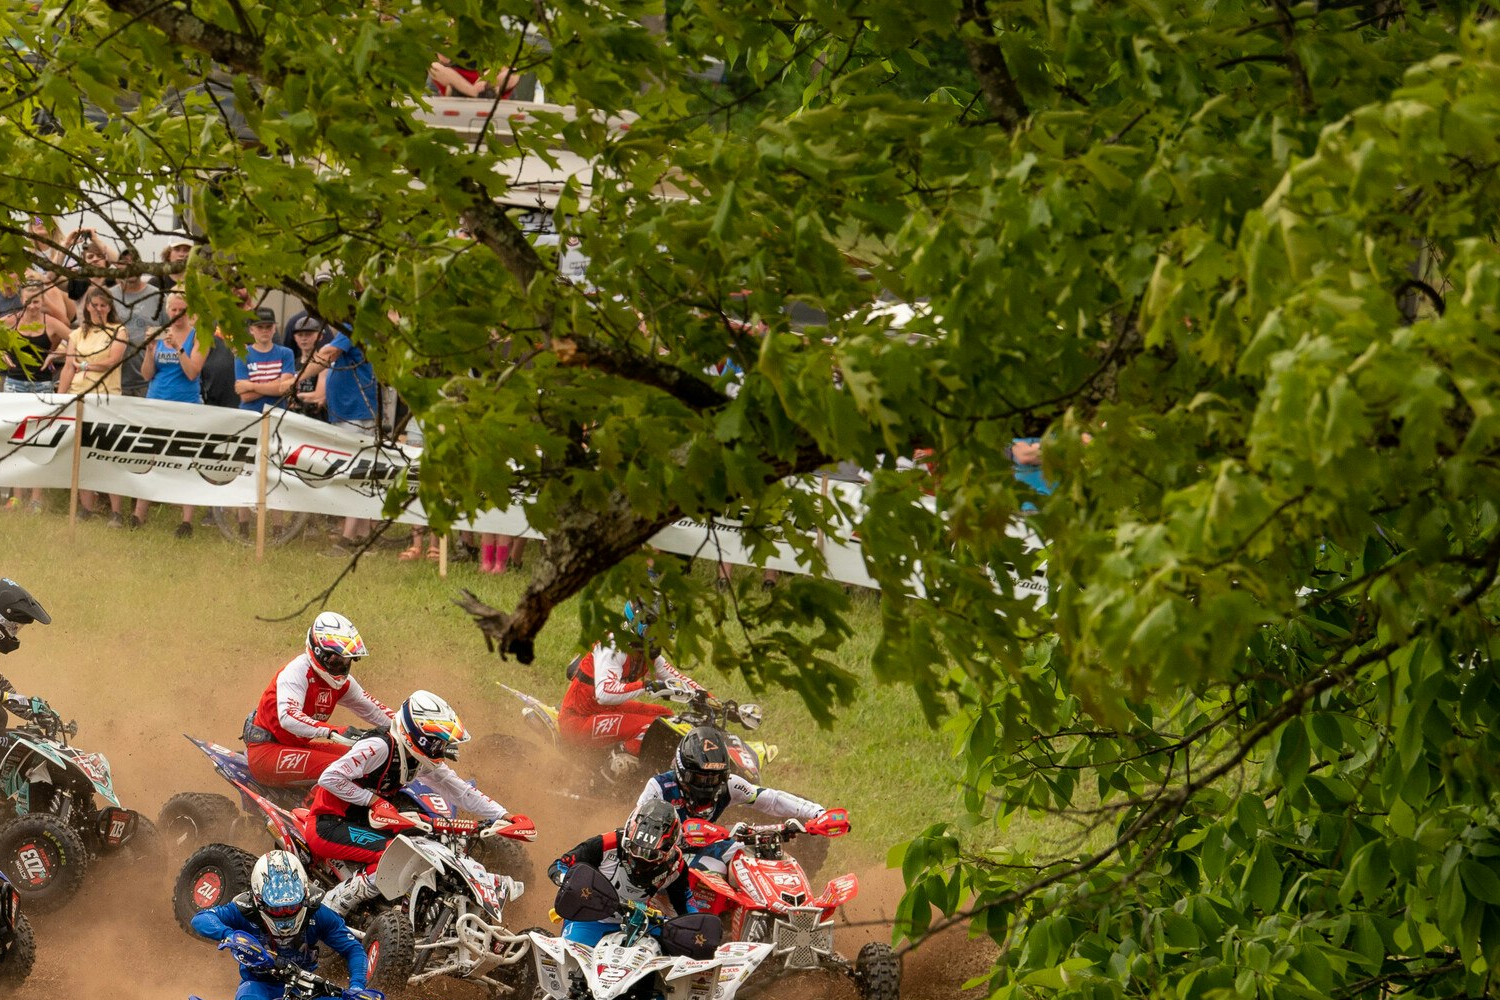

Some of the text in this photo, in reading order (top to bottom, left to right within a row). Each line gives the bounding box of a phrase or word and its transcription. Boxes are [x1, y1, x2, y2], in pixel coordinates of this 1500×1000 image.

[87, 451, 183, 470] Performance
[595, 719, 618, 735] FLY
[279, 753, 306, 770] FLY
[635, 831, 657, 844] FLY
[774, 874, 801, 886] 521
